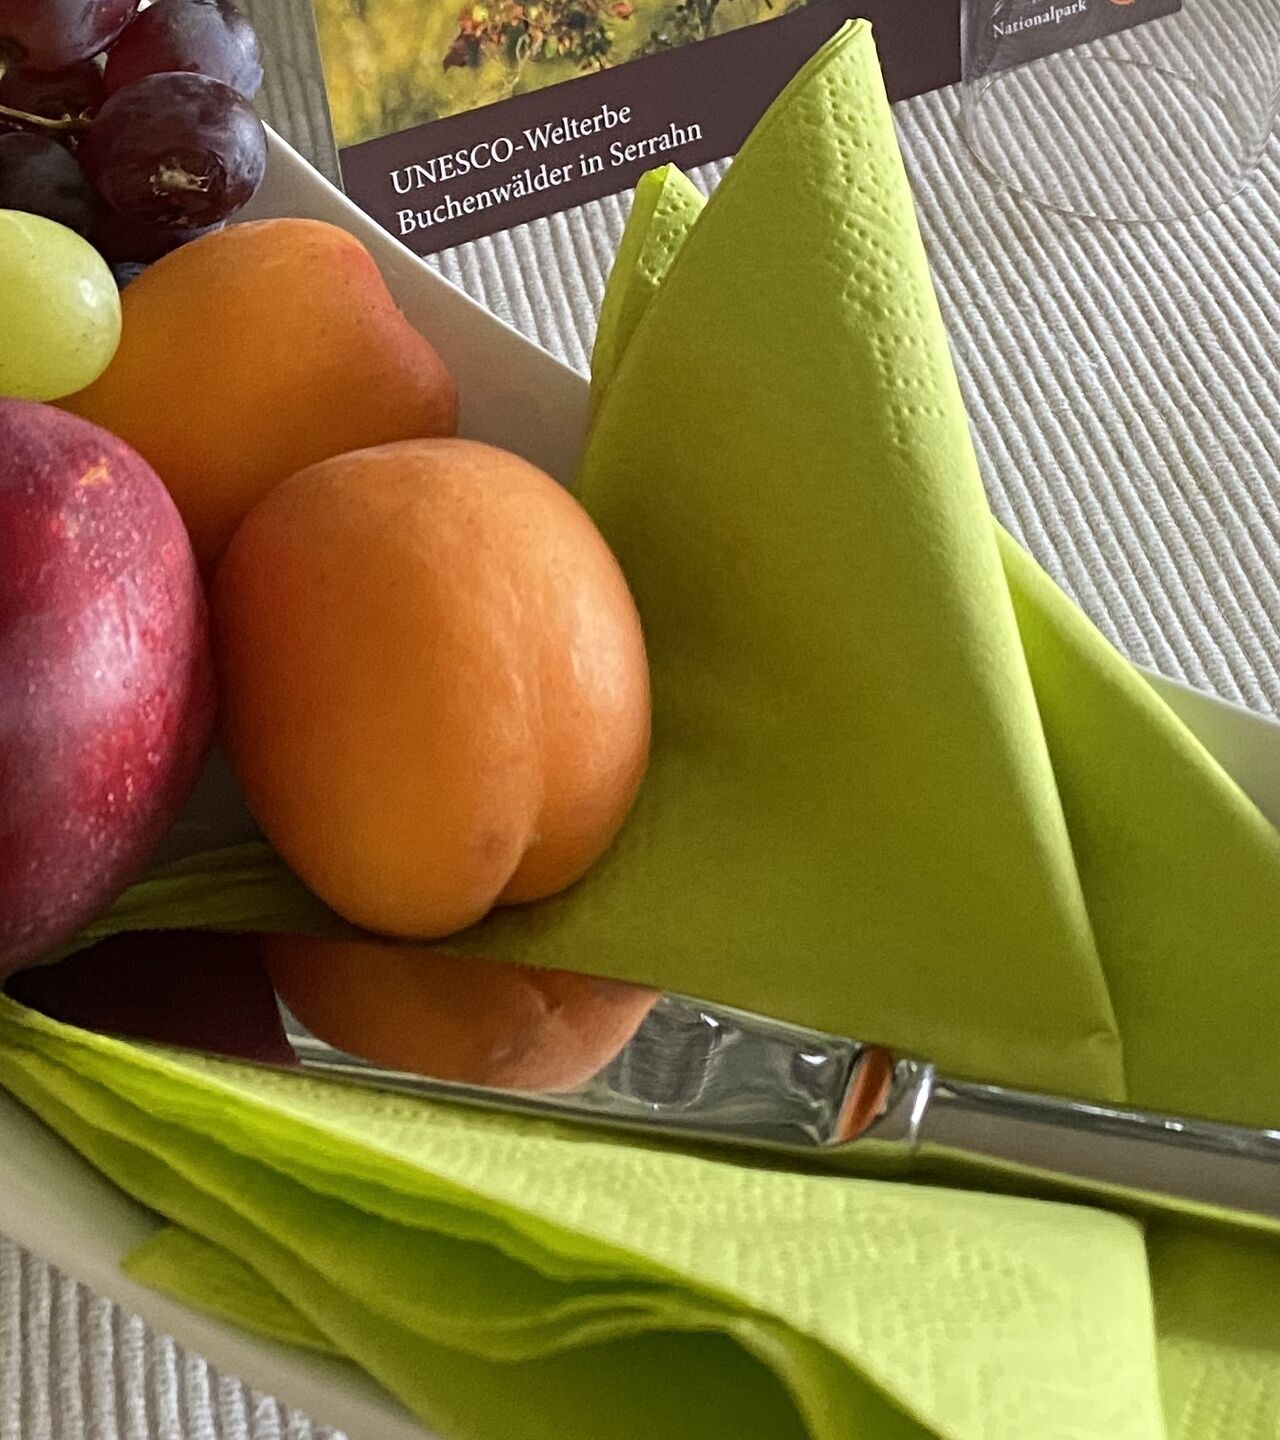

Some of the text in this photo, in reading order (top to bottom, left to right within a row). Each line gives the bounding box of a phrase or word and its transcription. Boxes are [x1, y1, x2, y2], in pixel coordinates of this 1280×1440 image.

[389, 104, 632, 195] UNESCO-Welterbe
[395, 123, 704, 236] Buchenwälder in Serrahn
